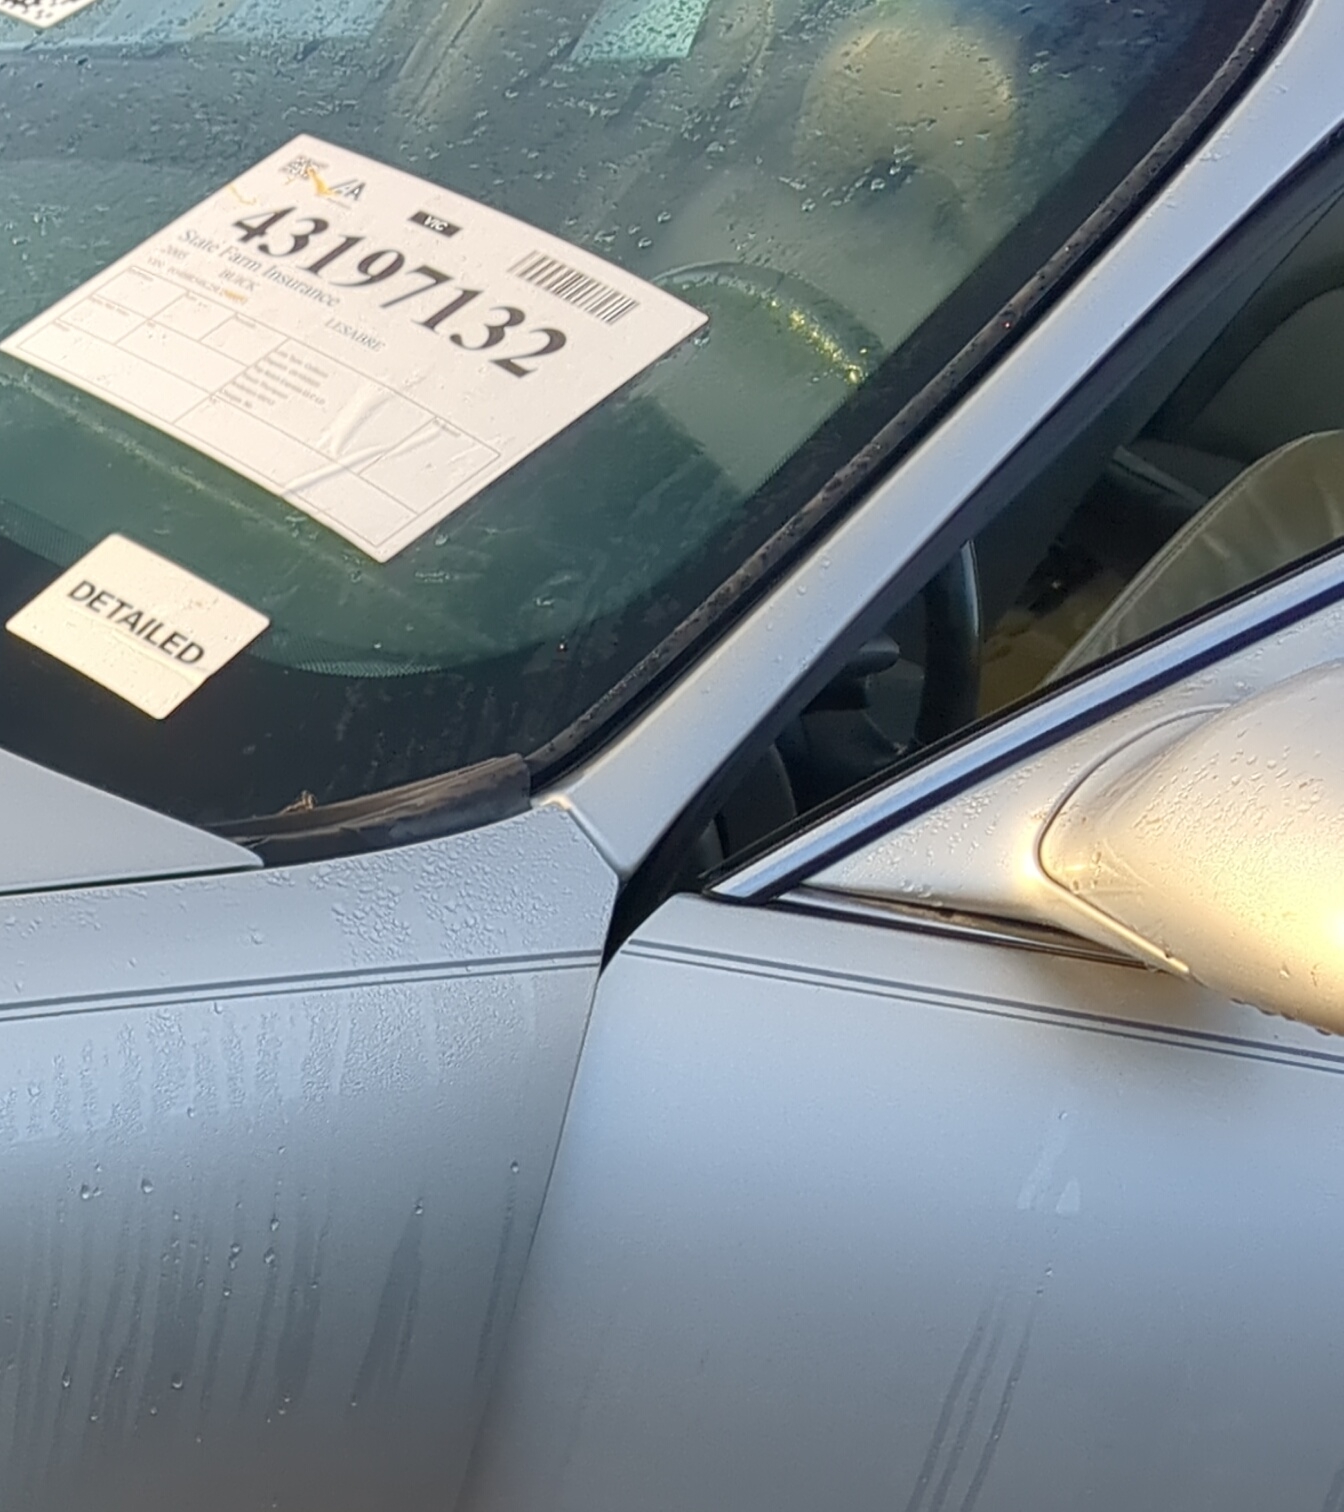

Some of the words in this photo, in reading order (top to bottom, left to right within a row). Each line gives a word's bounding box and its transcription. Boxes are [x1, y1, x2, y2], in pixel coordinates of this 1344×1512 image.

[423, 215, 449, 232] VIC
[179, 229, 219, 252] State
[219, 244, 262, 273] Farm
[264, 265, 340, 307] Insurance
[231, 206, 568, 378] 43197132
[324, 318, 385, 352] LESABRE
[68, 580, 204, 666] DETAILED
